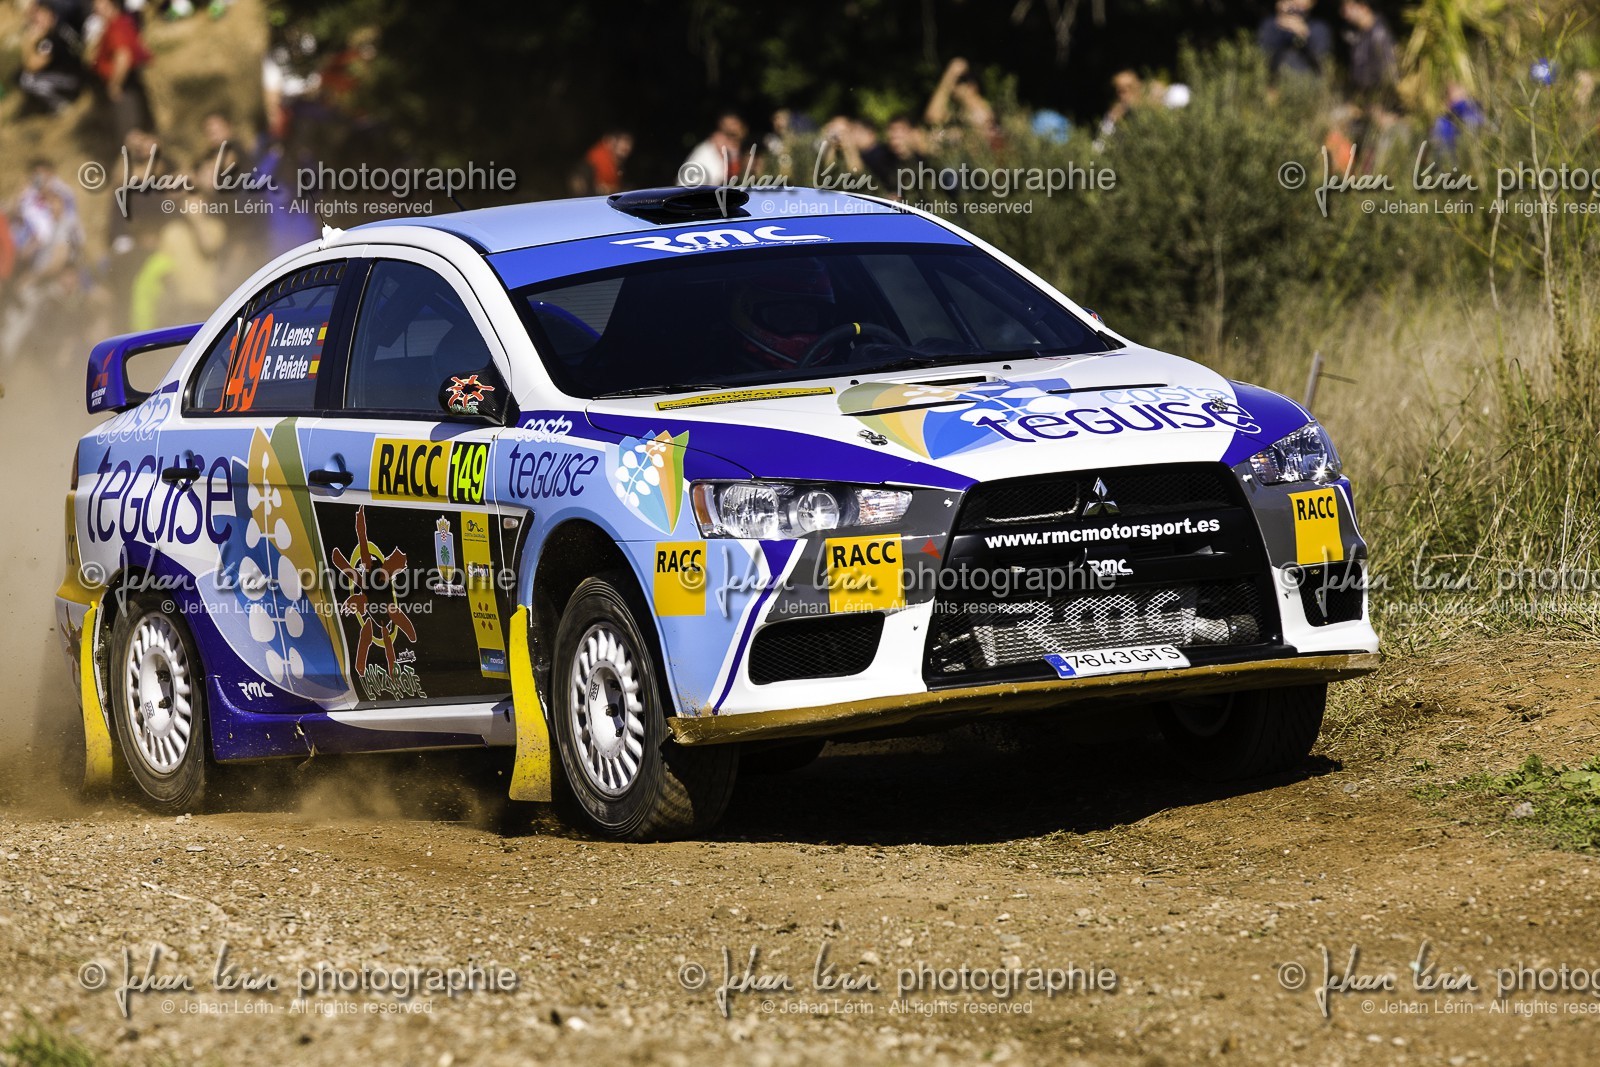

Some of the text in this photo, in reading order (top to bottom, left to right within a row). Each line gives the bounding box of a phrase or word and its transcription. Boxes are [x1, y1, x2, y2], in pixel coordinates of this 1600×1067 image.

[271, 323, 315, 347] Y. Lemes
[214, 313, 274, 412] 149
[260, 354, 308, 380] R. Peñate
[1100, 384, 1233, 405] costa
[97, 392, 171, 445] costa
[515, 415, 573, 443] costa
[378, 443, 442, 498] RACC
[452, 444, 486, 503] 149
[1296, 496, 1335, 521] RACC
[985, 518, 1220, 548] www.rmcmotorsport.es
[657, 550, 702, 572] RACC
[832, 541, 897, 568] RACC
